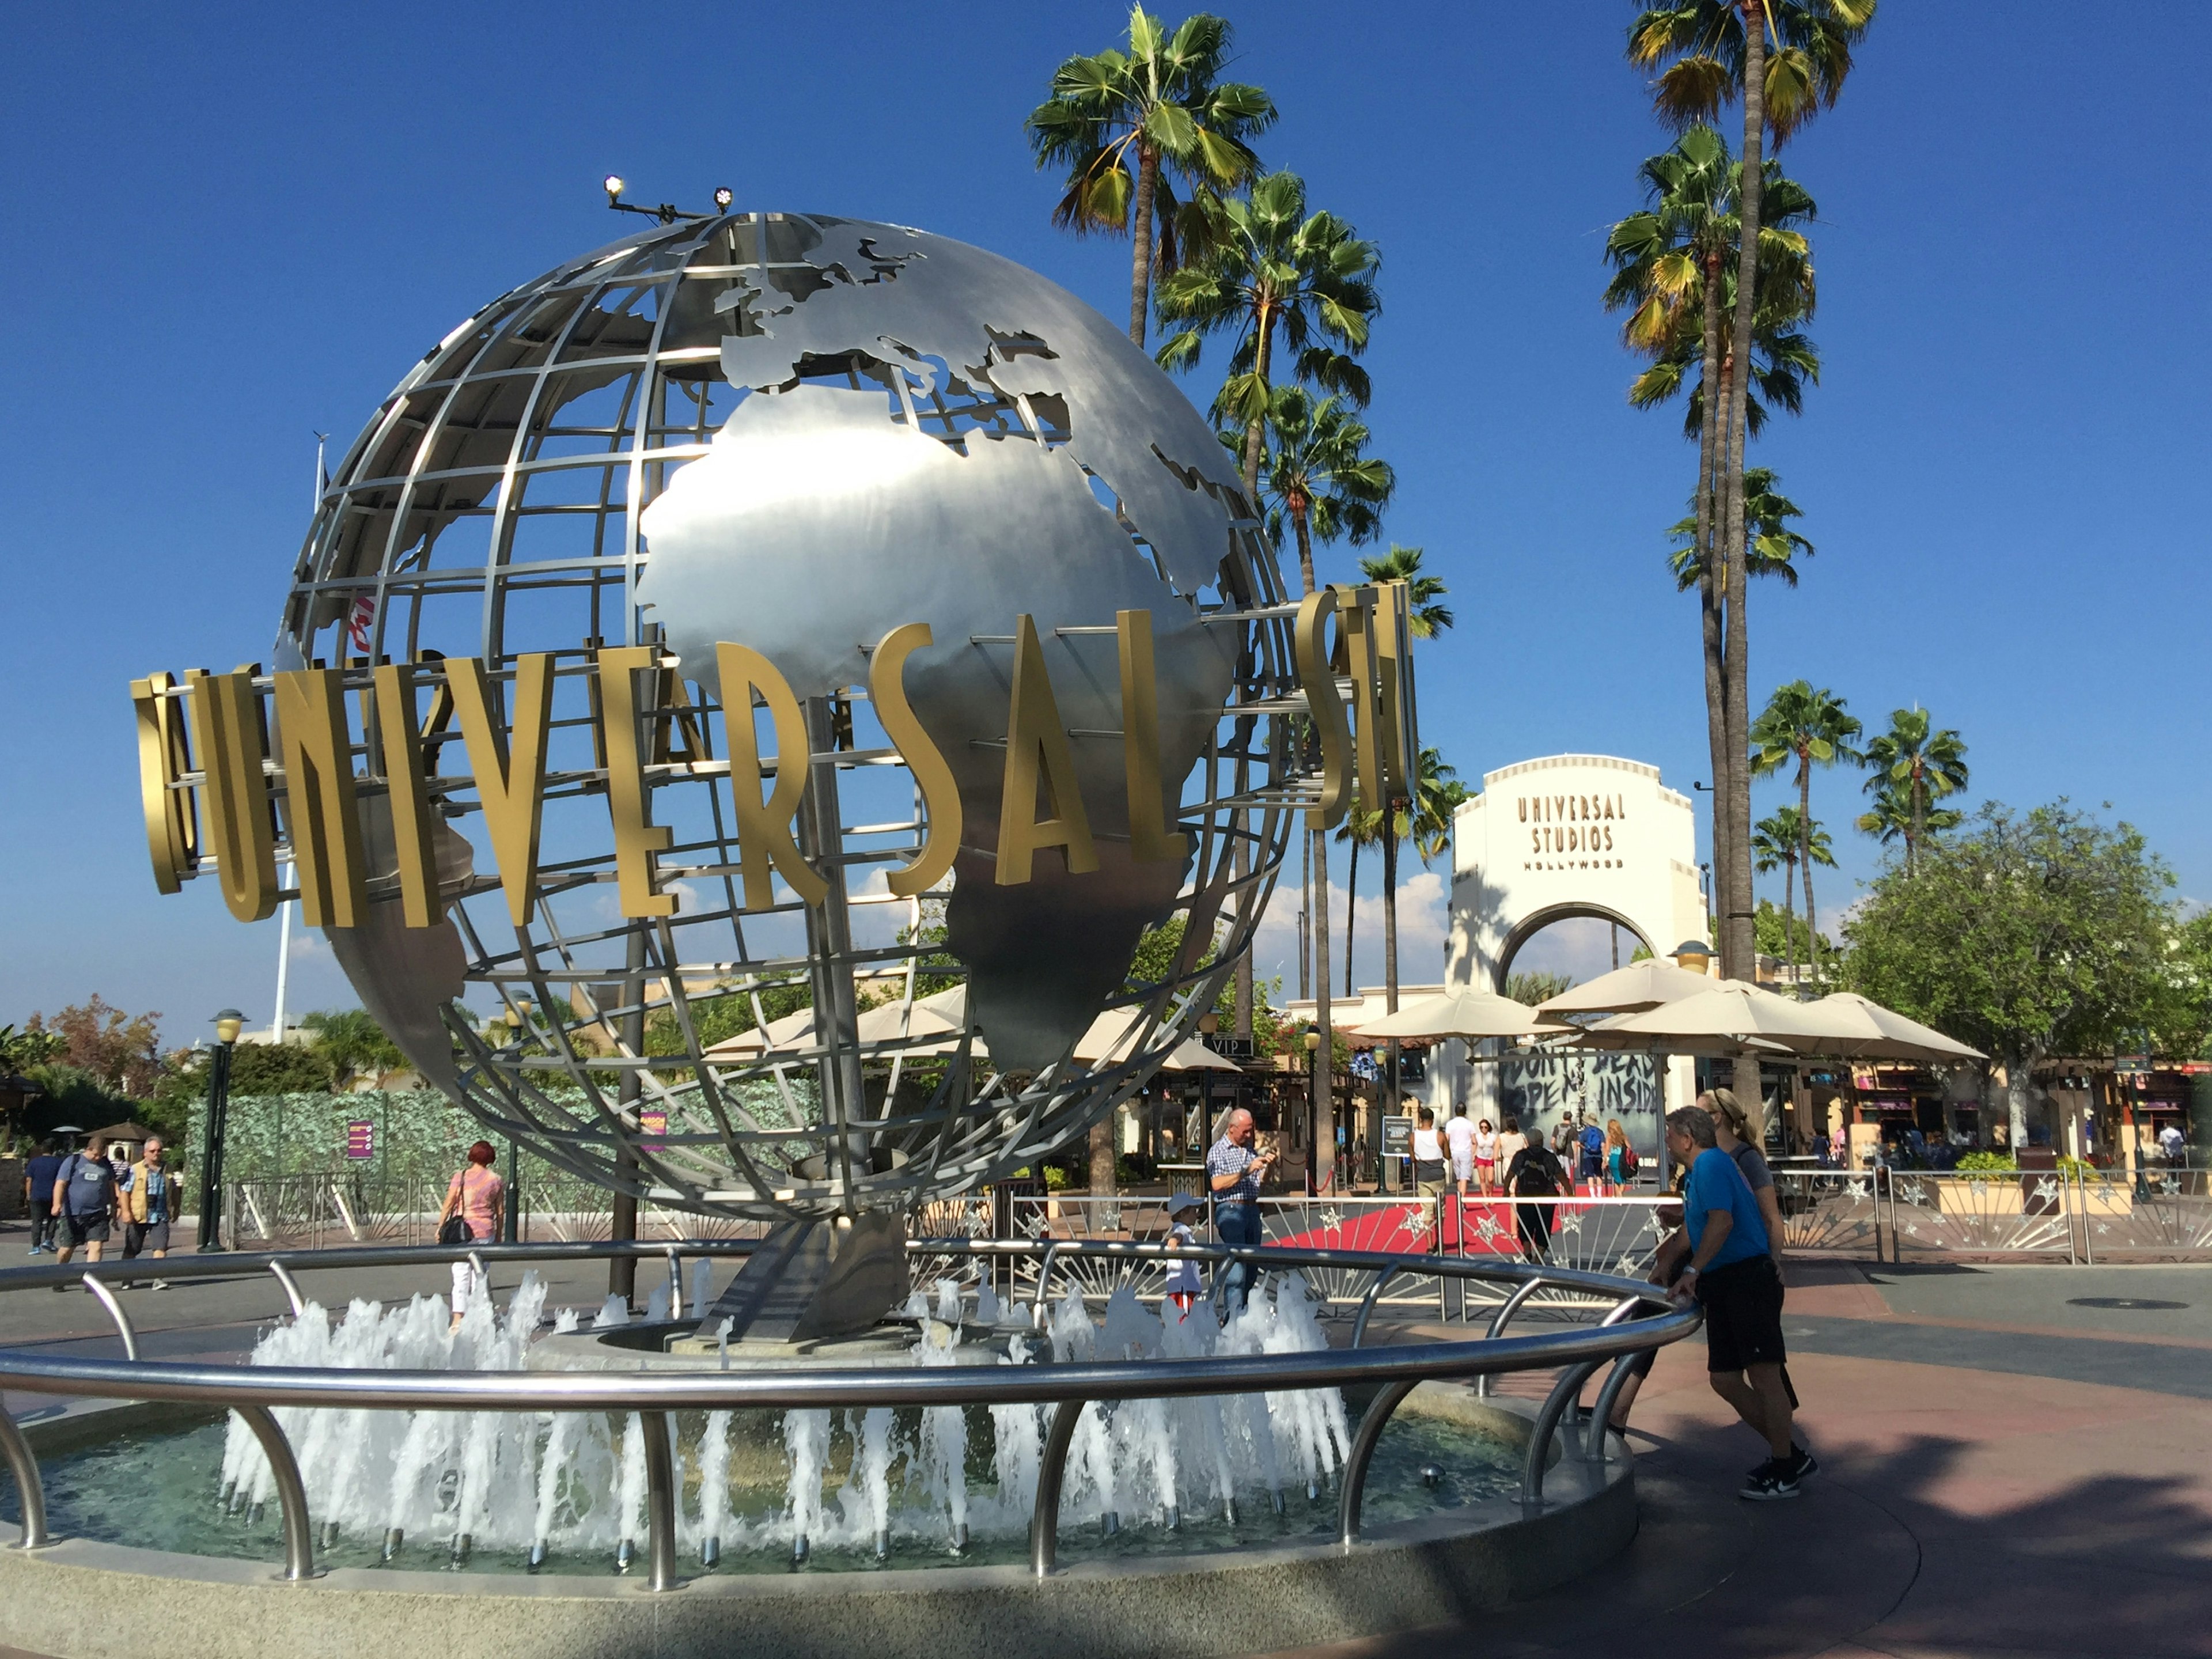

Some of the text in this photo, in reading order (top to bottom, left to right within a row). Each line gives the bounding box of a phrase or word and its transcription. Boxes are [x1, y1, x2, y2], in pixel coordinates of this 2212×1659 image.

[194, 610, 1188, 927] UNIVERSAL
[1518, 793, 1625, 823] UNIVERSAL
[1532, 825, 1613, 854] STUDIOS
[1524, 859, 1623, 871] HOLLYWOOD
[1213, 1040, 1238, 1054] VIP
[1508, 1044, 1656, 1084] DONT DEAD
